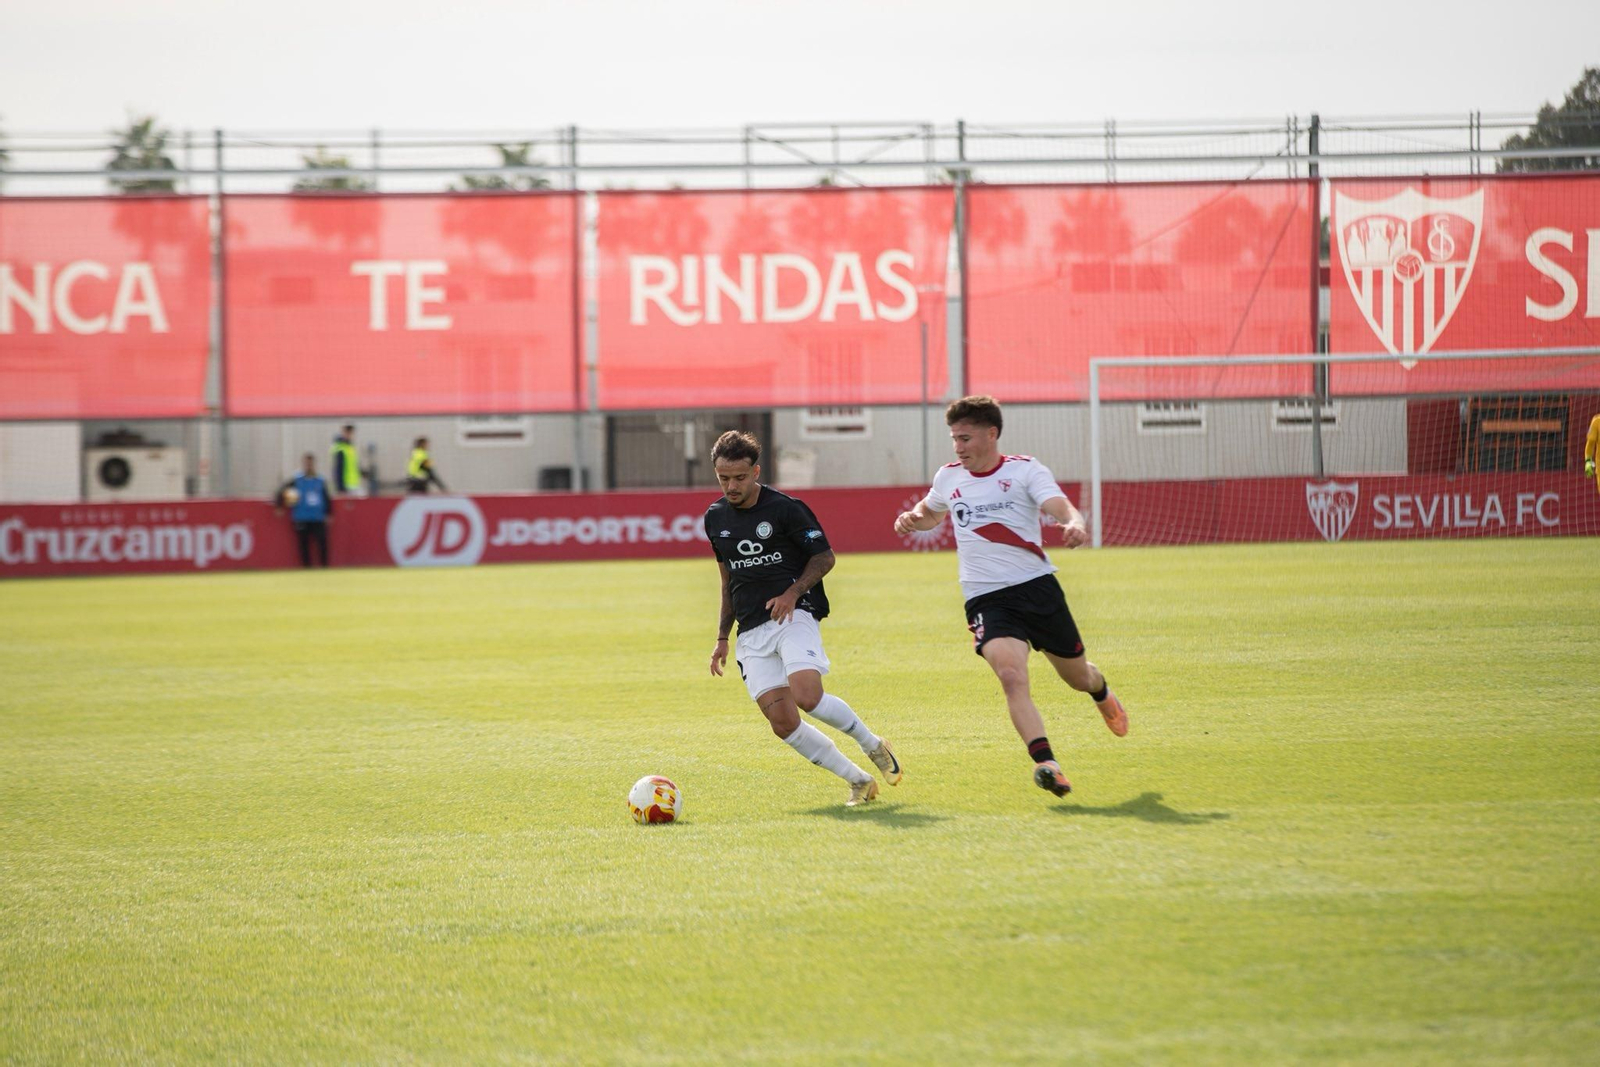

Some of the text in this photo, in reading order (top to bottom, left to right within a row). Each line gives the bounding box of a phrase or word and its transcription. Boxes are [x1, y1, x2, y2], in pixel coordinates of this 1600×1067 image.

[350, 259, 452, 331] TE
[628, 249, 919, 327] RINDAS
[1525, 226, 1600, 322] S
[403, 510, 472, 557] JD
[1373, 491, 1560, 529] SEVILLA FC
[0, 516, 254, 567] Cruzcampo
